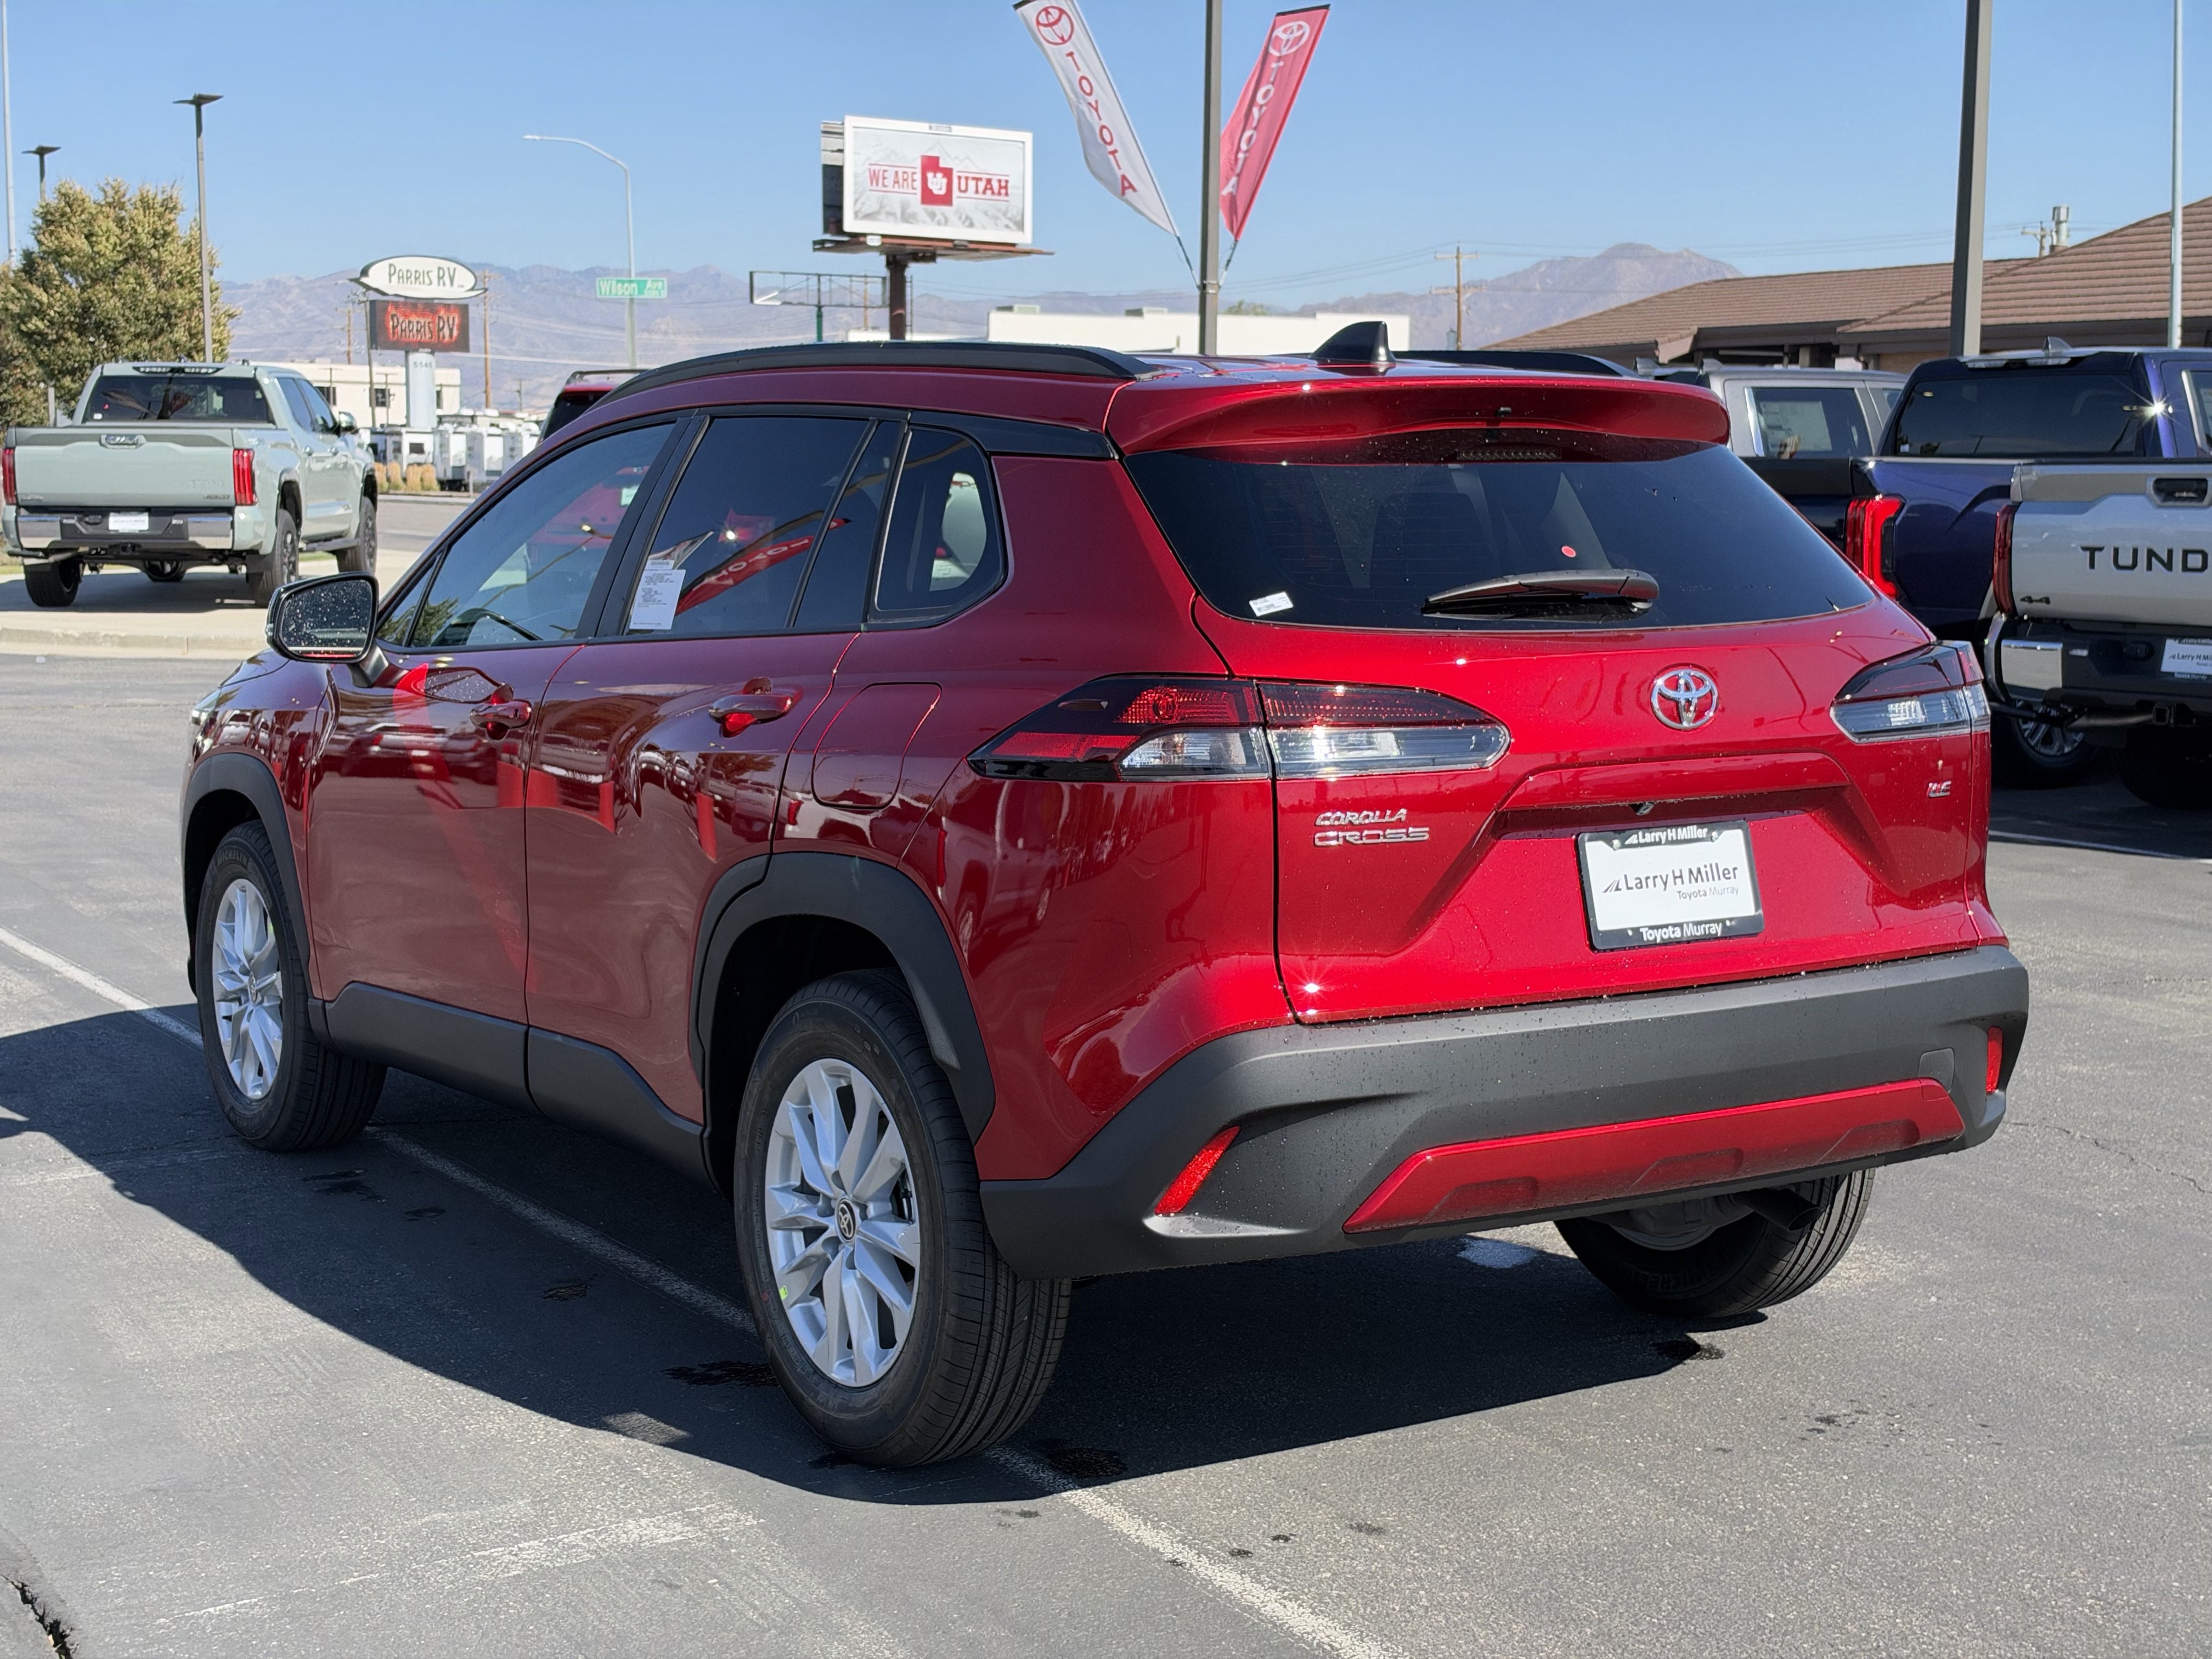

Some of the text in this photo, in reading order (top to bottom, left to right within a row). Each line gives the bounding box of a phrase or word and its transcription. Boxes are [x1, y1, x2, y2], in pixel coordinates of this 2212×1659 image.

[1066, 51, 1138, 196] TOYOTA
[1221, 61, 1284, 195] TOYOTA
[868, 168, 888, 188] WE
[892, 171, 917, 190] ARE
[957, 175, 1009, 197] UTAH
[437, 267, 456, 288] RV
[600, 280, 638, 295] Wilson
[437, 314, 455, 341] RV
[1315, 808, 1407, 826] COROLLA
[1314, 827, 1430, 847] CROSS
[1638, 825, 1708, 844] Larry H Miller
[1624, 862, 1739, 891] Larry H Miller
[1677, 885, 1739, 900] Toyota Murray
[1639, 922, 1723, 943] Toyota Murray
